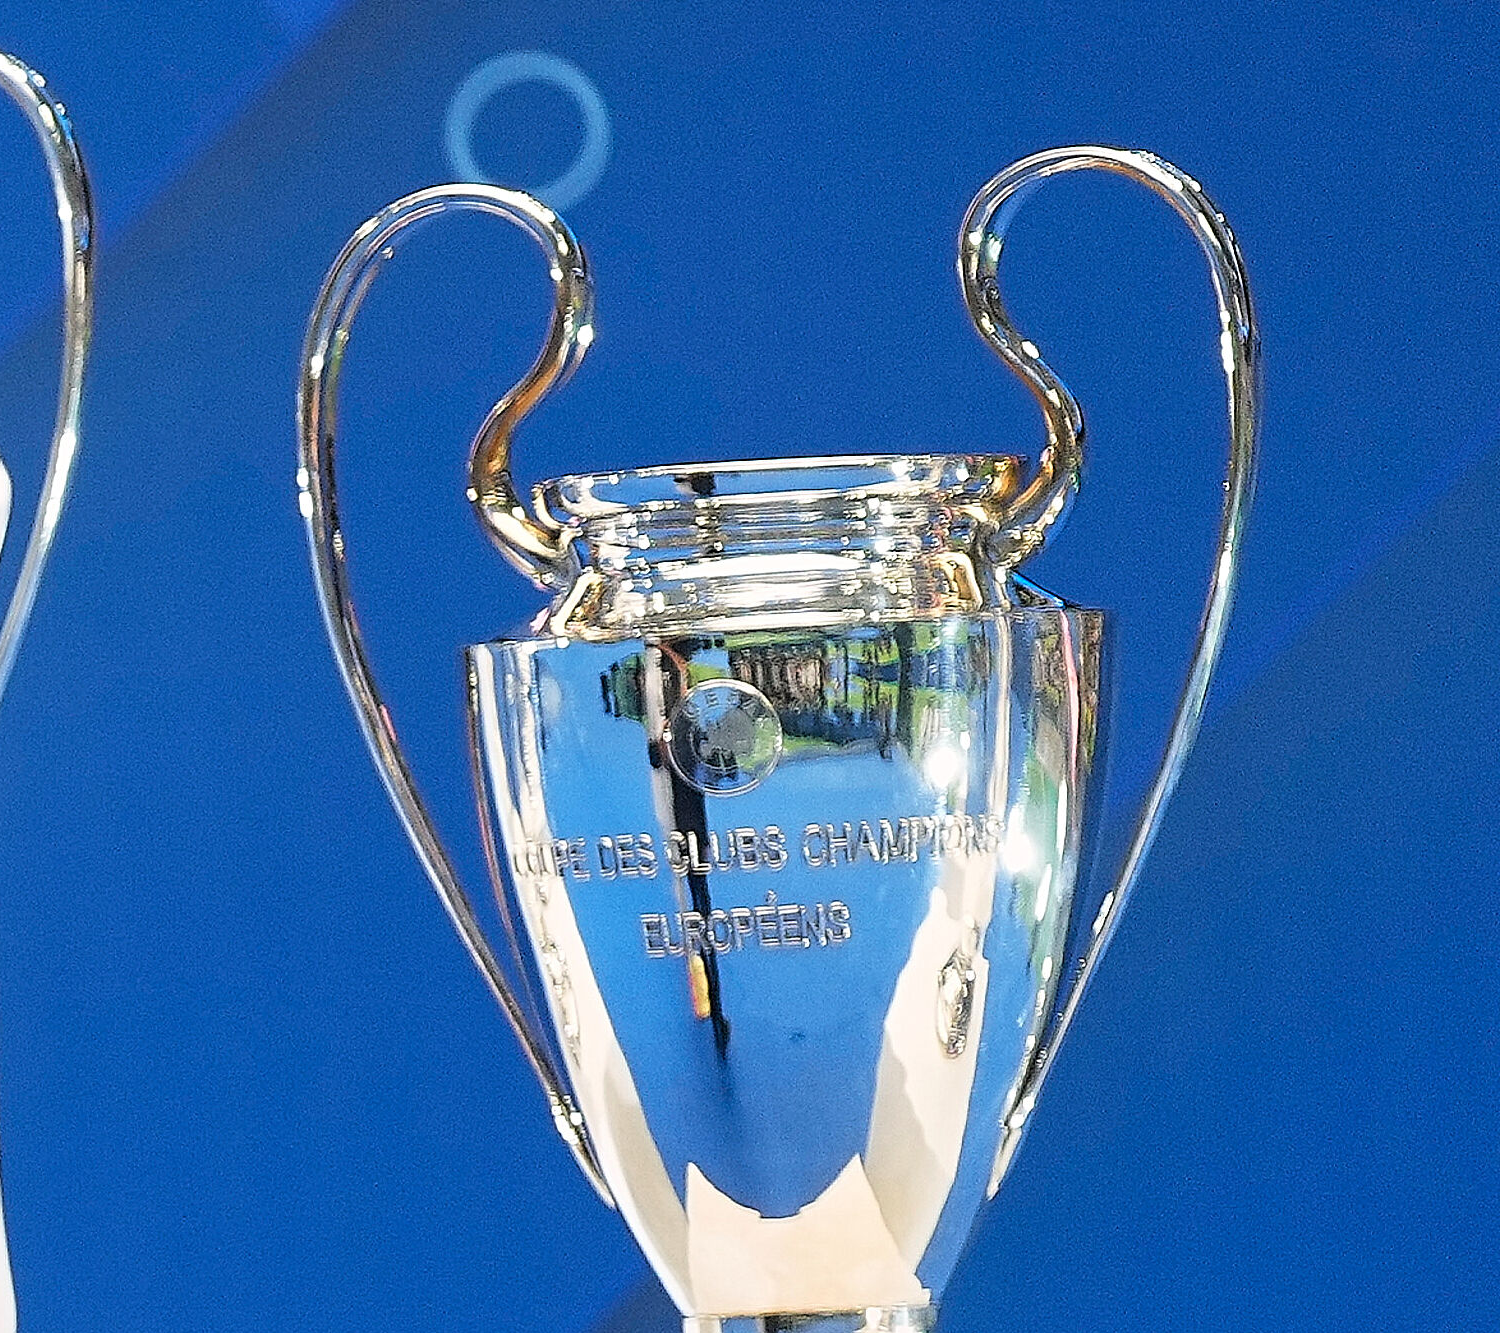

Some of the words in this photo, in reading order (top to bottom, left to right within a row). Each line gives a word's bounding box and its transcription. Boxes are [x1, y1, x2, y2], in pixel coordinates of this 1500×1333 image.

[598, 833, 658, 880] DES
[664, 825, 789, 877] CLUBS
[803, 813, 1006, 868] CHAMPIONS
[640, 889, 852, 959] EUROPÉENS
